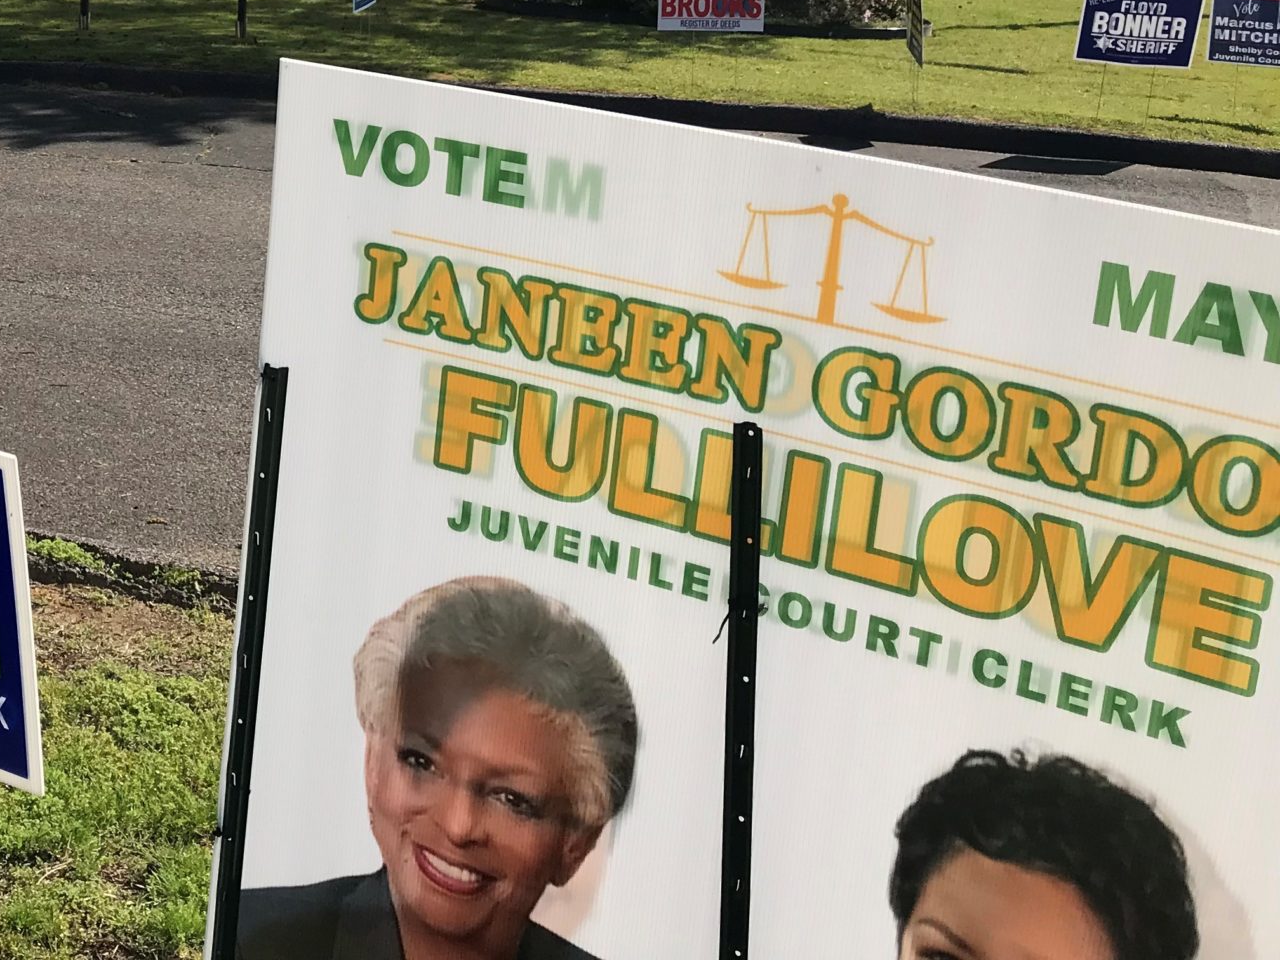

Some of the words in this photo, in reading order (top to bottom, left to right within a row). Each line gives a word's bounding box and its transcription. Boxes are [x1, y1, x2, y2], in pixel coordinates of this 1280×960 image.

[1121, 0, 1167, 15] FLOYD
[1233, 0, 1260, 17] Vote
[680, 20, 710, 28] REGISTER
[711, 20, 719, 28] OF
[720, 20, 741, 28] DEEDS
[1092, 11, 1187, 40] BONNER
[1215, 16, 1274, 30] Marcus
[1214, 28, 1280, 44] MITCH
[1116, 39, 1178, 54] SHERIFF
[1229, 45, 1263, 56] Shelby
[1266, 48, 1280, 56] Co
[1213, 53, 1255, 62] Juvenile
[332, 119, 527, 209] VOTE
[354, 243, 781, 414] JANEEN
[812, 346, 1280, 538] GORDO
[435, 365, 1274, 697] FULLILOVE
[447, 499, 711, 603] JUVENILE
[971, 647, 1191, 748] CLERK
